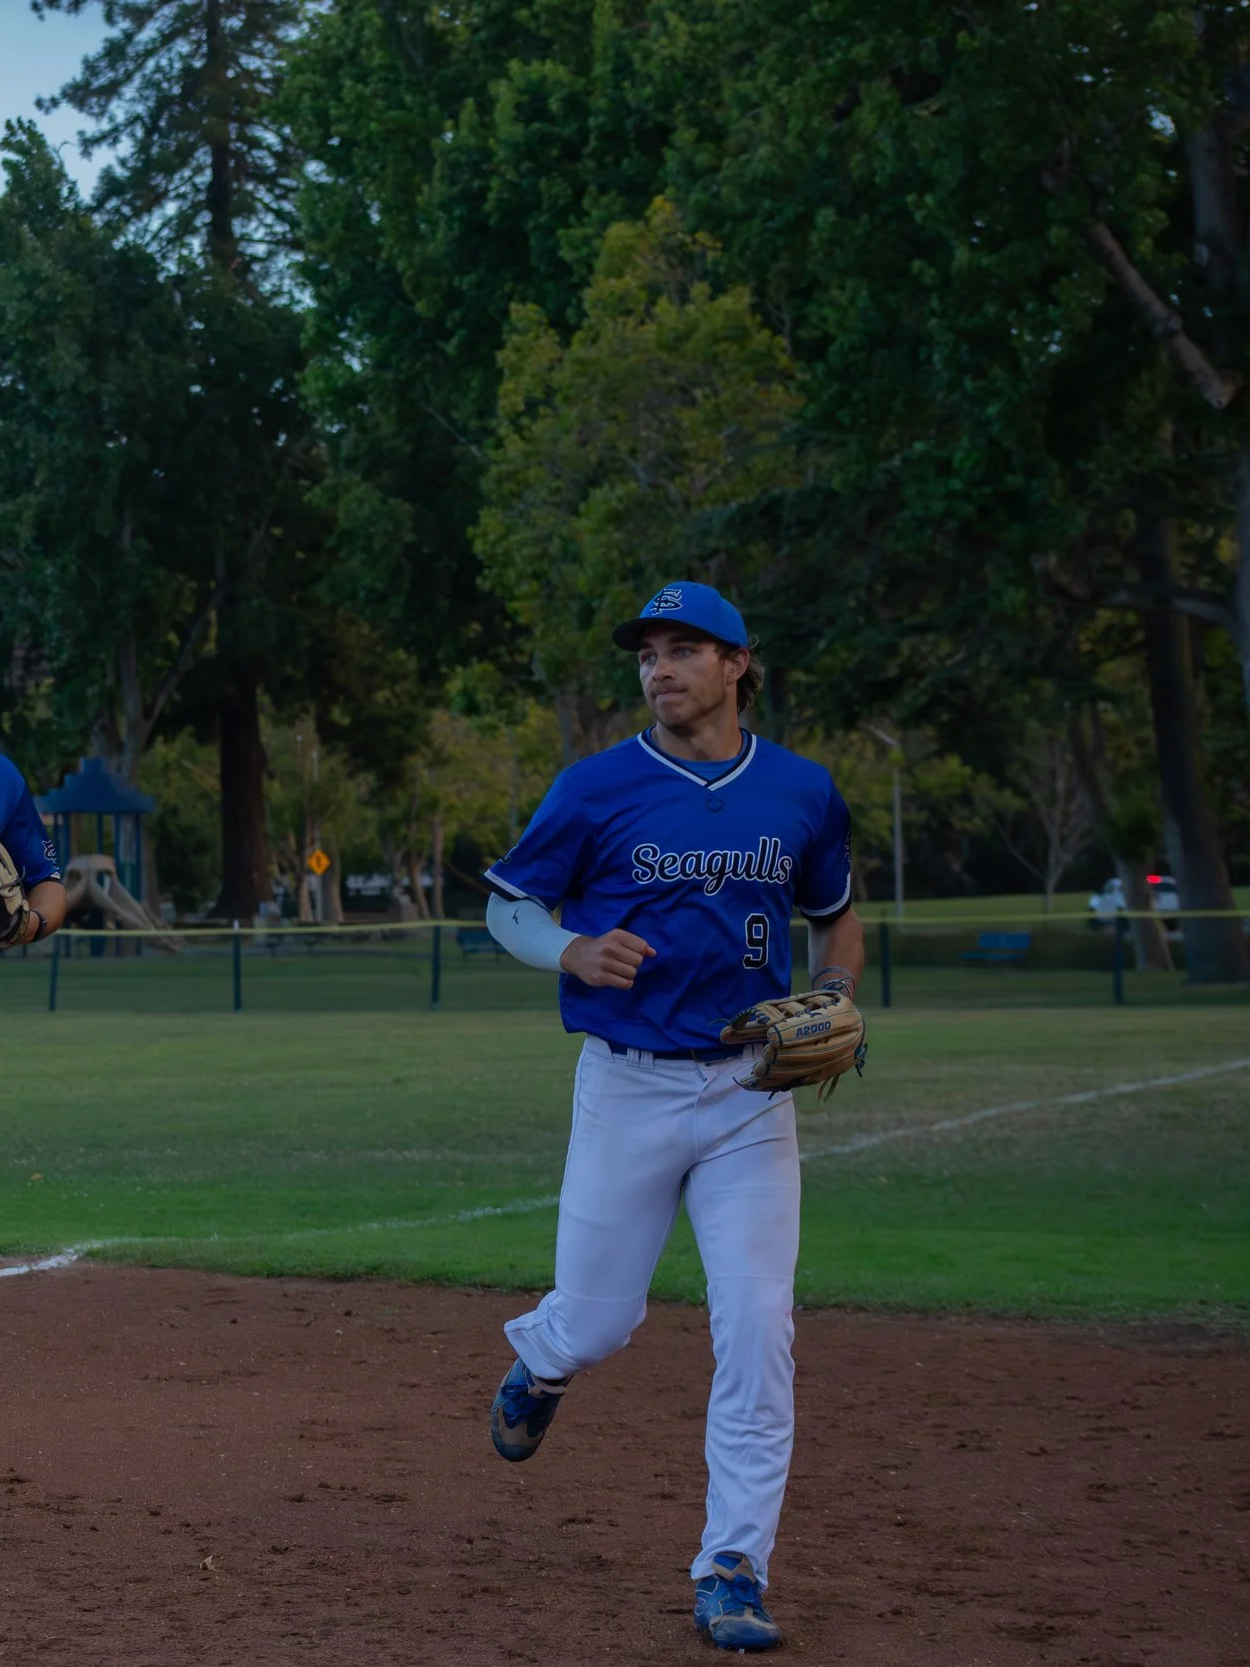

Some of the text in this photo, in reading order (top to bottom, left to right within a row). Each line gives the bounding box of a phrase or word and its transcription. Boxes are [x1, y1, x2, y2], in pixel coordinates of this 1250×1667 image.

[632, 836, 793, 896] Seagulls
[742, 913, 770, 970] 9
[796, 1021, 831, 1038] A2000
